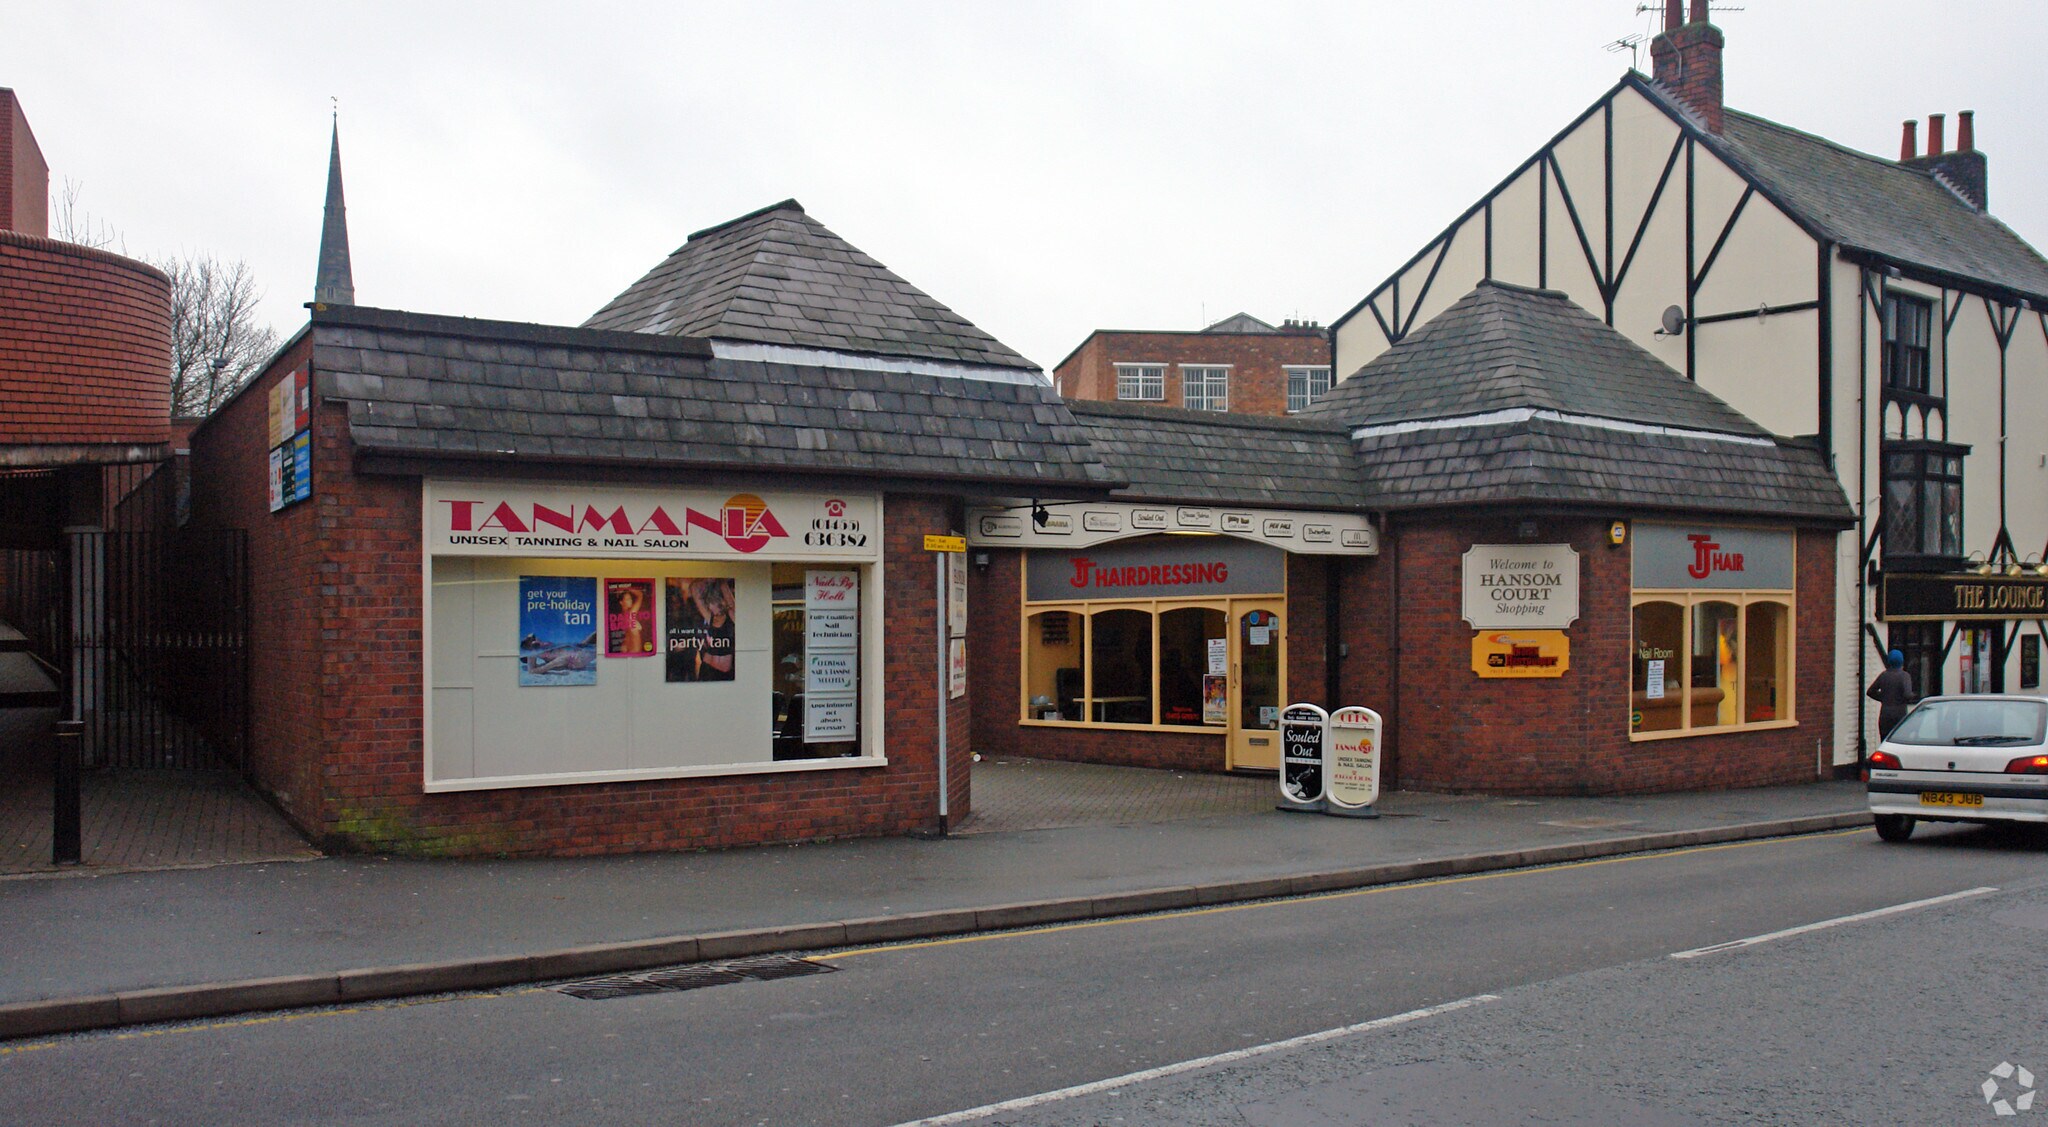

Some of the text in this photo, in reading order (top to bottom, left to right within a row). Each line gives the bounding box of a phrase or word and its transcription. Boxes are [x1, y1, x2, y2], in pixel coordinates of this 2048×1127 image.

[438, 500, 790, 538] TANMANIA
[812, 518, 860, 532] (01455)
[450, 536, 689, 548] UNISEX TANNING & NAIL SALON
[804, 532, 867, 548] 636382
[1490, 559, 1554, 570] Welcome to
[1713, 552, 1744, 571] HAIR
[1096, 562, 1228, 588] HAIRDRESSING
[1480, 574, 1562, 586] HANSOM
[528, 590, 568, 600] get your
[1491, 588, 1552, 600] COURT
[1954, 585, 2044, 608] THE LOUNGE
[528, 600, 590, 612] pre-holiday
[1496, 602, 1546, 616] Shopping
[564, 612, 590, 625] tan
[670, 637, 730, 651] party tan
[1654, 648, 1674, 658] Room
[1286, 729, 1321, 744] Souled
[1292, 744, 1313, 757] Out
[1922, 793, 1983, 805] N843 JUB
